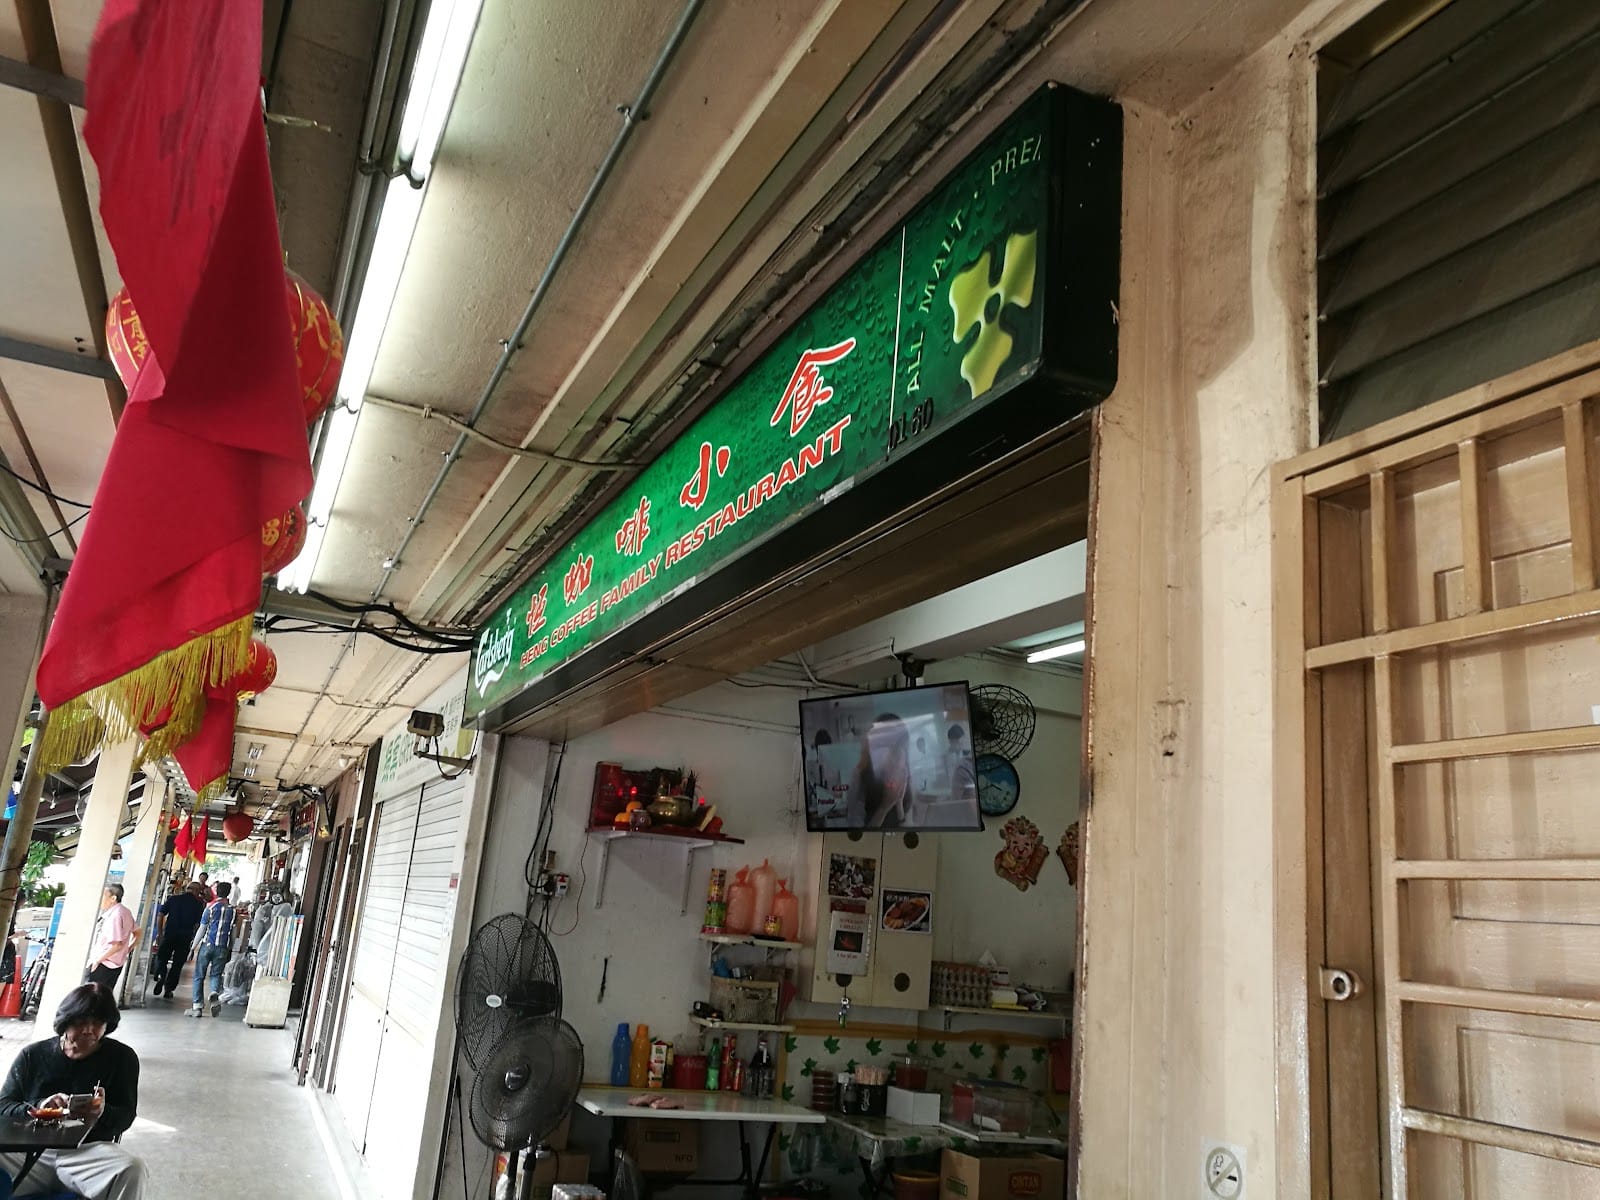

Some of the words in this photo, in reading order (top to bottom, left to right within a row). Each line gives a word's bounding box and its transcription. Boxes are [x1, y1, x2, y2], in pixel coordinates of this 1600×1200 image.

[907, 329, 925, 395] ALL
[919, 209, 964, 314] MALT
[520, 636, 549, 670] HENG
[550, 601, 598, 648] COFFEE
[600, 554, 662, 615] FAMILY
[664, 416, 851, 569] RESTAURANT
[475, 624, 516, 698] Carlsberg
